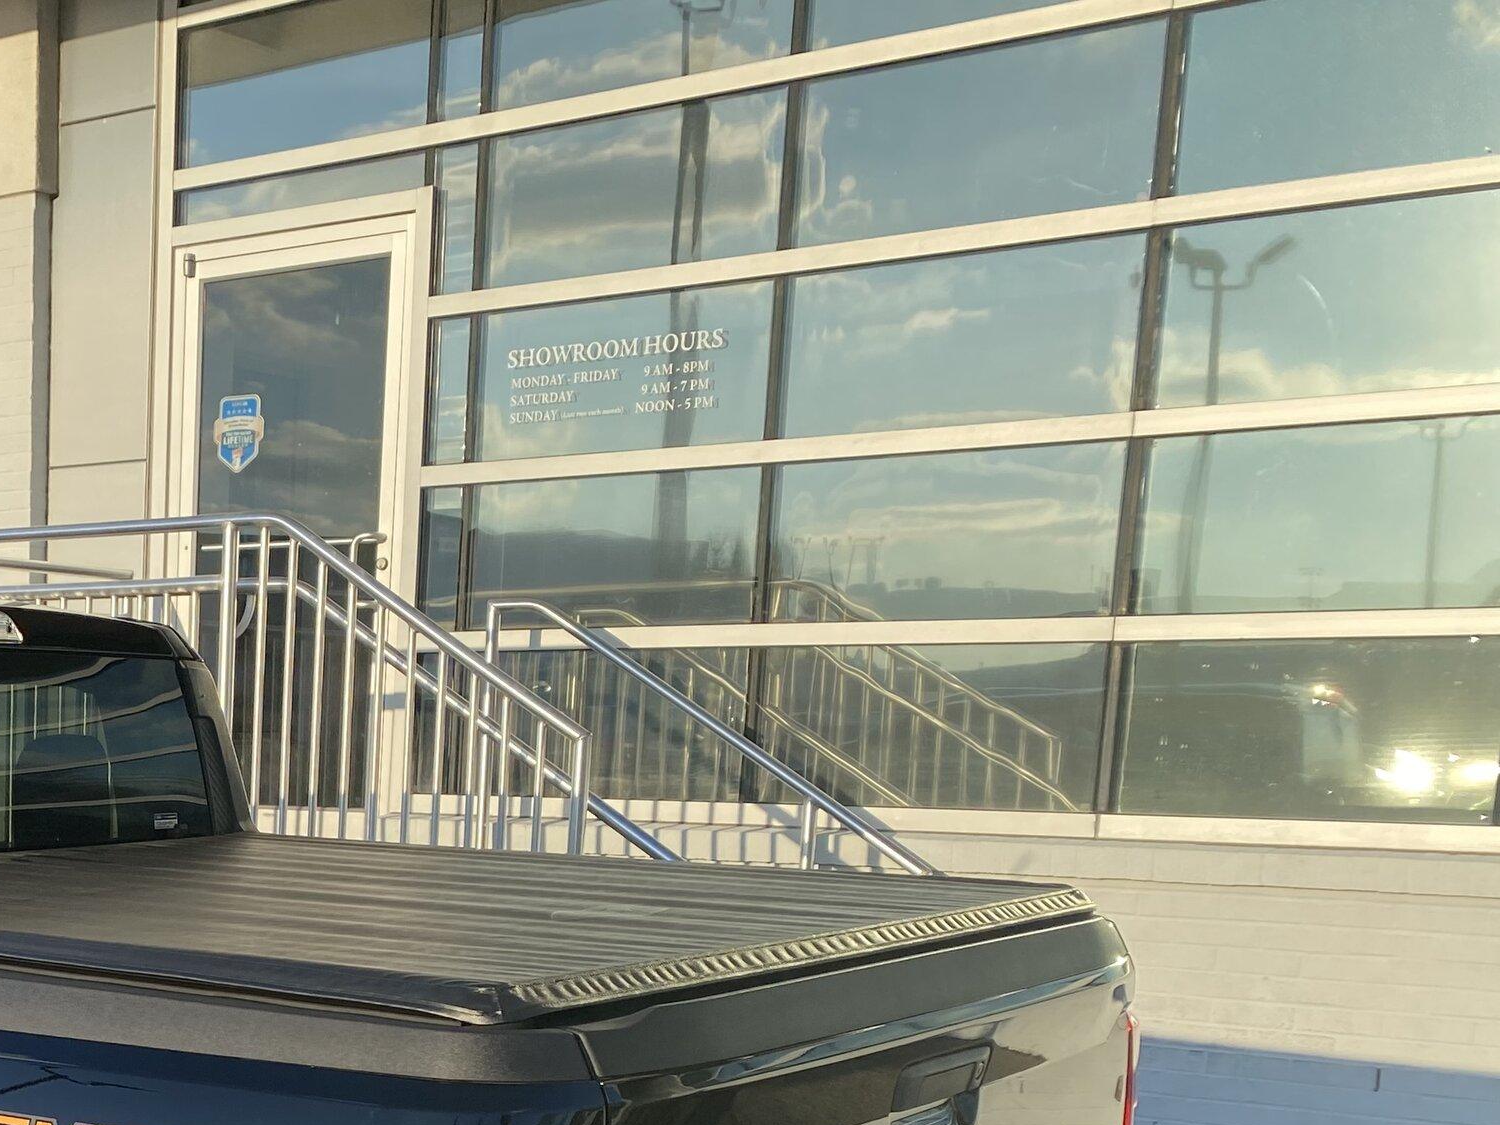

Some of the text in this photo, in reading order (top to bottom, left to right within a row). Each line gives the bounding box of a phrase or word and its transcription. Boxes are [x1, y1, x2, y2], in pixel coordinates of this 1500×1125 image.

[507, 328, 724, 369] SHOWROOM HOURS
[511, 373, 564, 390] MONDAY
[573, 367, 619, 384] FRIDAY
[653, 363, 673, 376] AM
[510, 391, 574, 407] SATURDAY
[650, 381, 671, 394] AM
[690, 378, 709, 391] PM
[510, 410, 557, 424] SUNDAY
[635, 399, 675, 413] NOON
[694, 395, 714, 409] PM
[223, 434, 254, 446] LIFETIME
